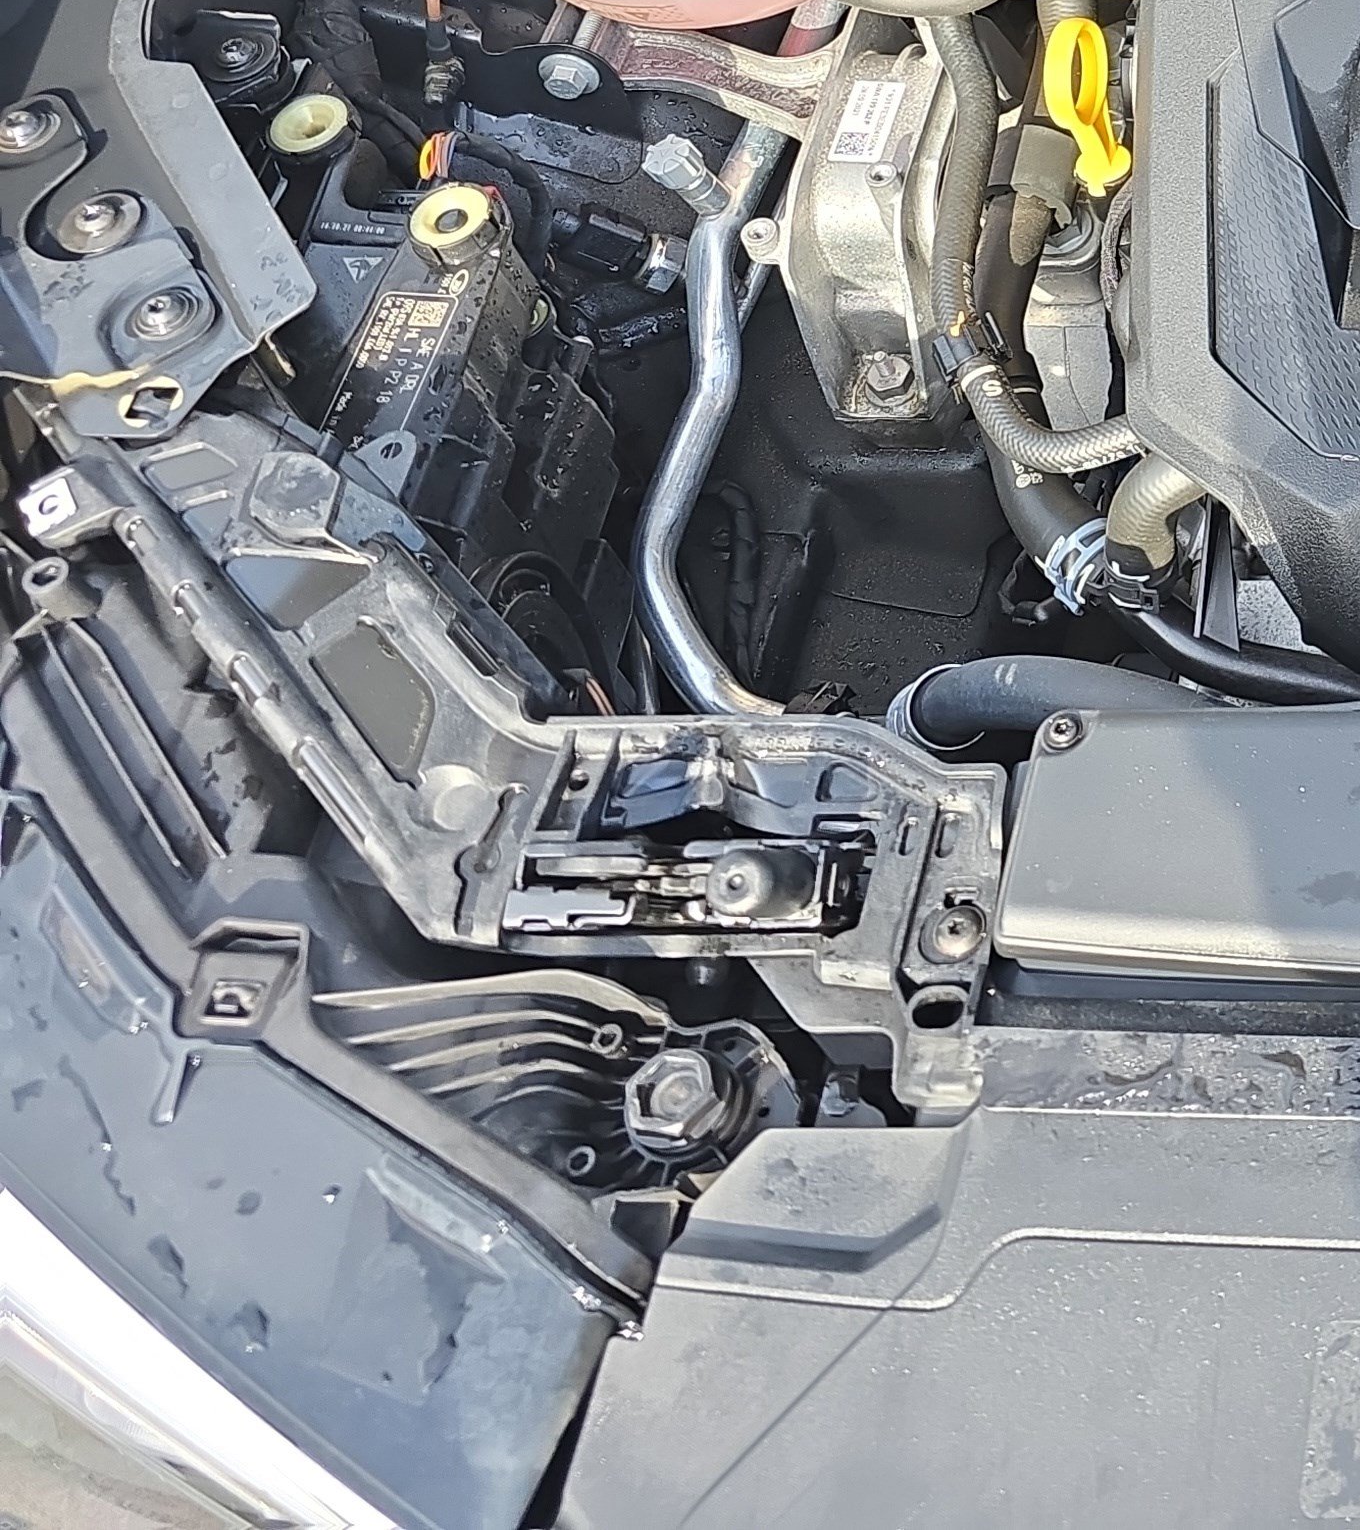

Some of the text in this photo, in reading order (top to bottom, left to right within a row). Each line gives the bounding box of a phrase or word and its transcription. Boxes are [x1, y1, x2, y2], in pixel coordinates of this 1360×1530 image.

[410, 361, 424, 370] A
[982, 379, 1003, 397] S
[376, 390, 393, 404] 18
